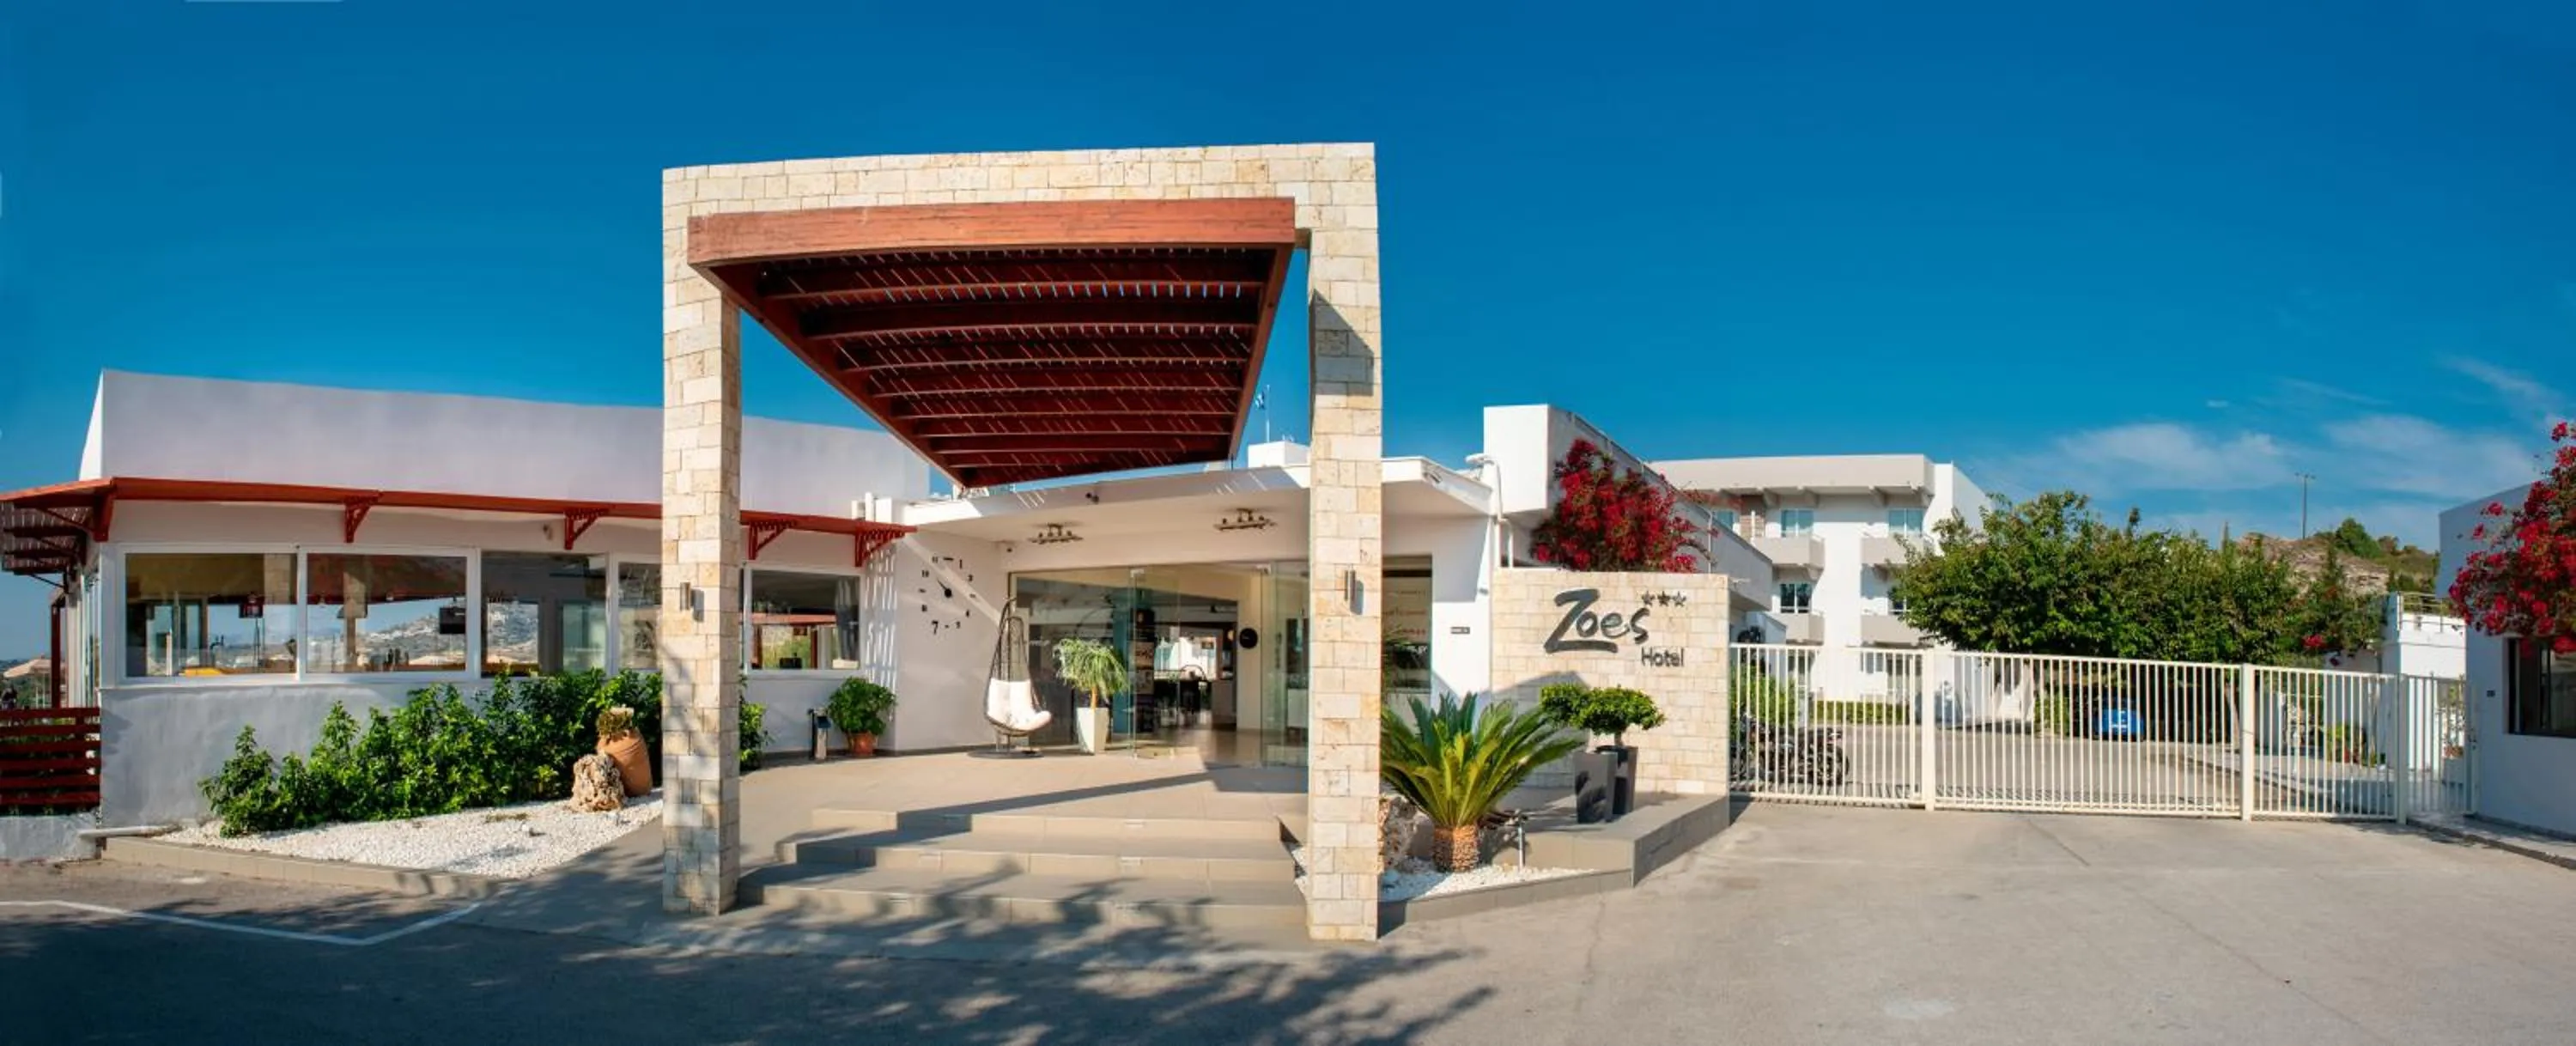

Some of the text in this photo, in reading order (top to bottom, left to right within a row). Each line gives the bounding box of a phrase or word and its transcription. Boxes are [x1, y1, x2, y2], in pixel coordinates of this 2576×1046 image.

[932, 619, 939, 635] 7
[1544, 588, 1650, 654] Zoes
[1641, 647, 1685, 667] Hotel
